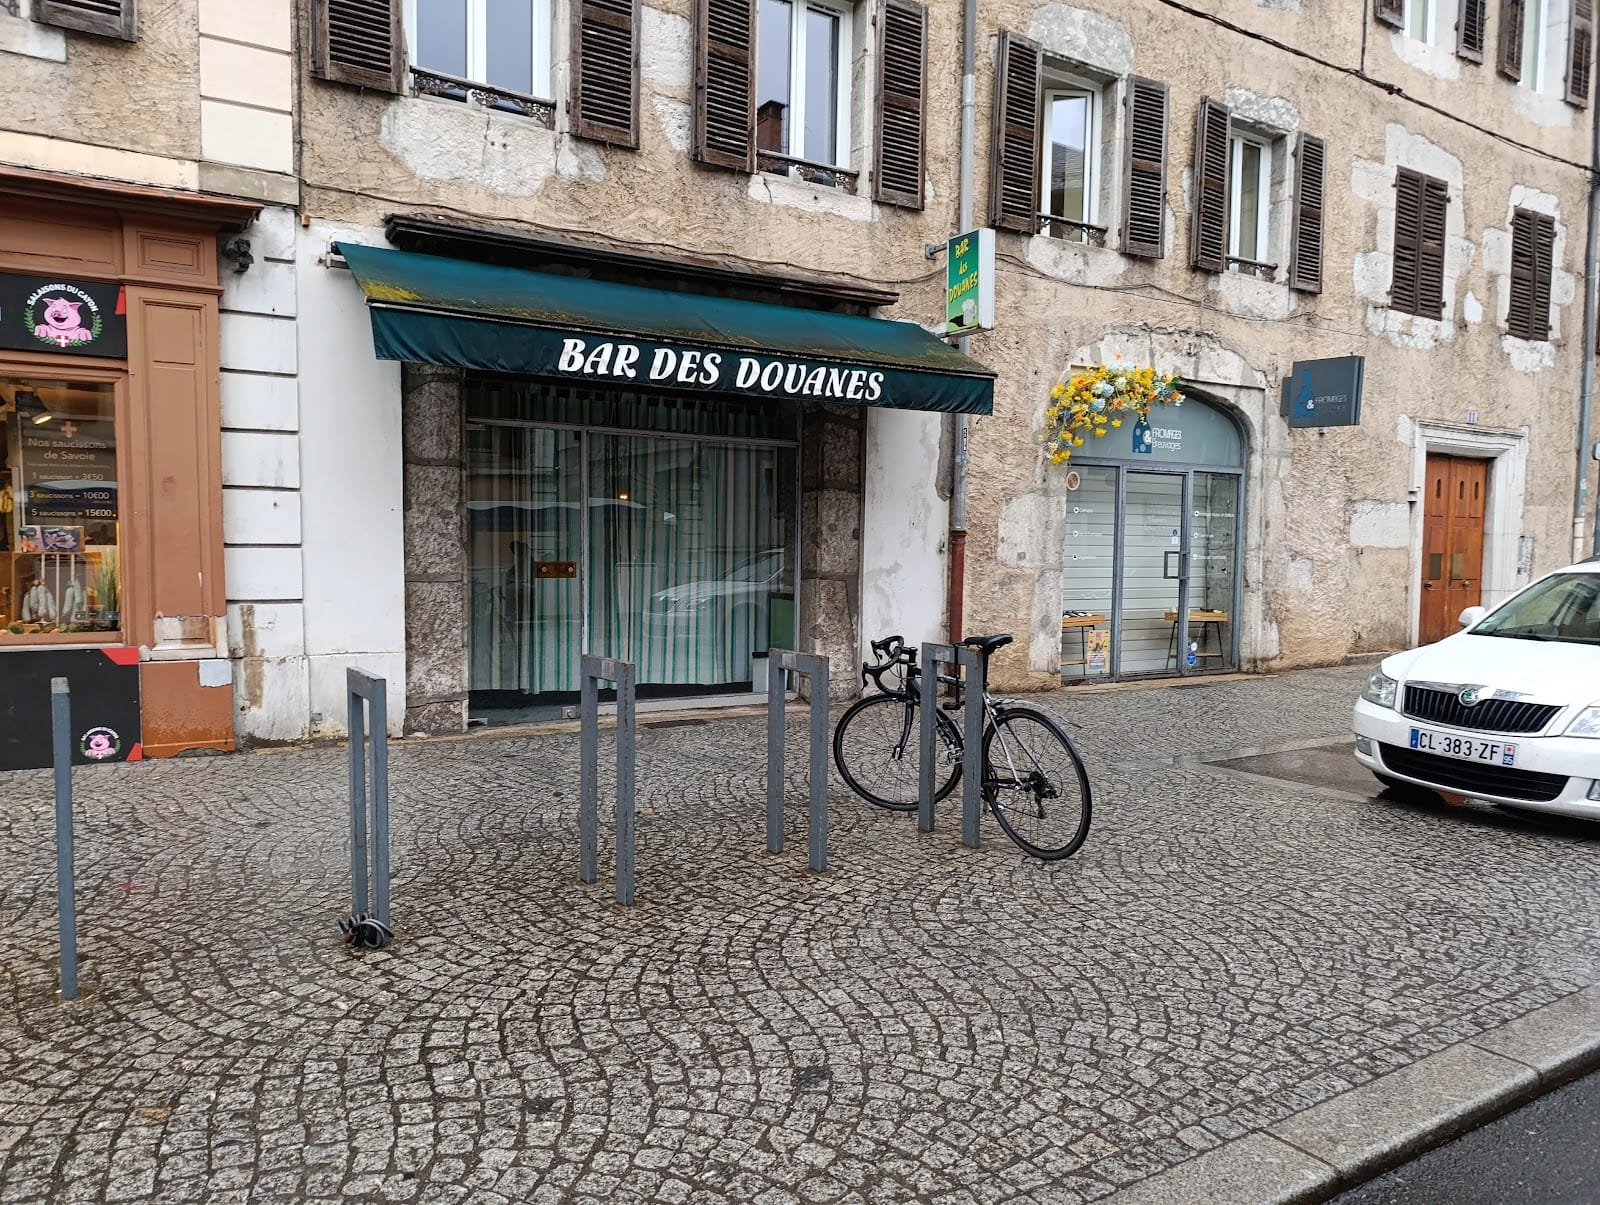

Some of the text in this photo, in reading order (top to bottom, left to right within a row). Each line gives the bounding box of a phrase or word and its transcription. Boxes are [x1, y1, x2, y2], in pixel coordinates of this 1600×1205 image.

[955, 238, 969, 258] BAR
[949, 271, 978, 302] DOUANES
[26, 283, 99, 312] SALAISONS DU CAYON
[558, 338, 884, 401] BAR DES DOUANES
[28, 438, 108, 449] Nos saucissons
[43, 450, 96, 461] de Savoie
[82, 491, 110, 500] 10€00
[31, 508, 38, 516] 5
